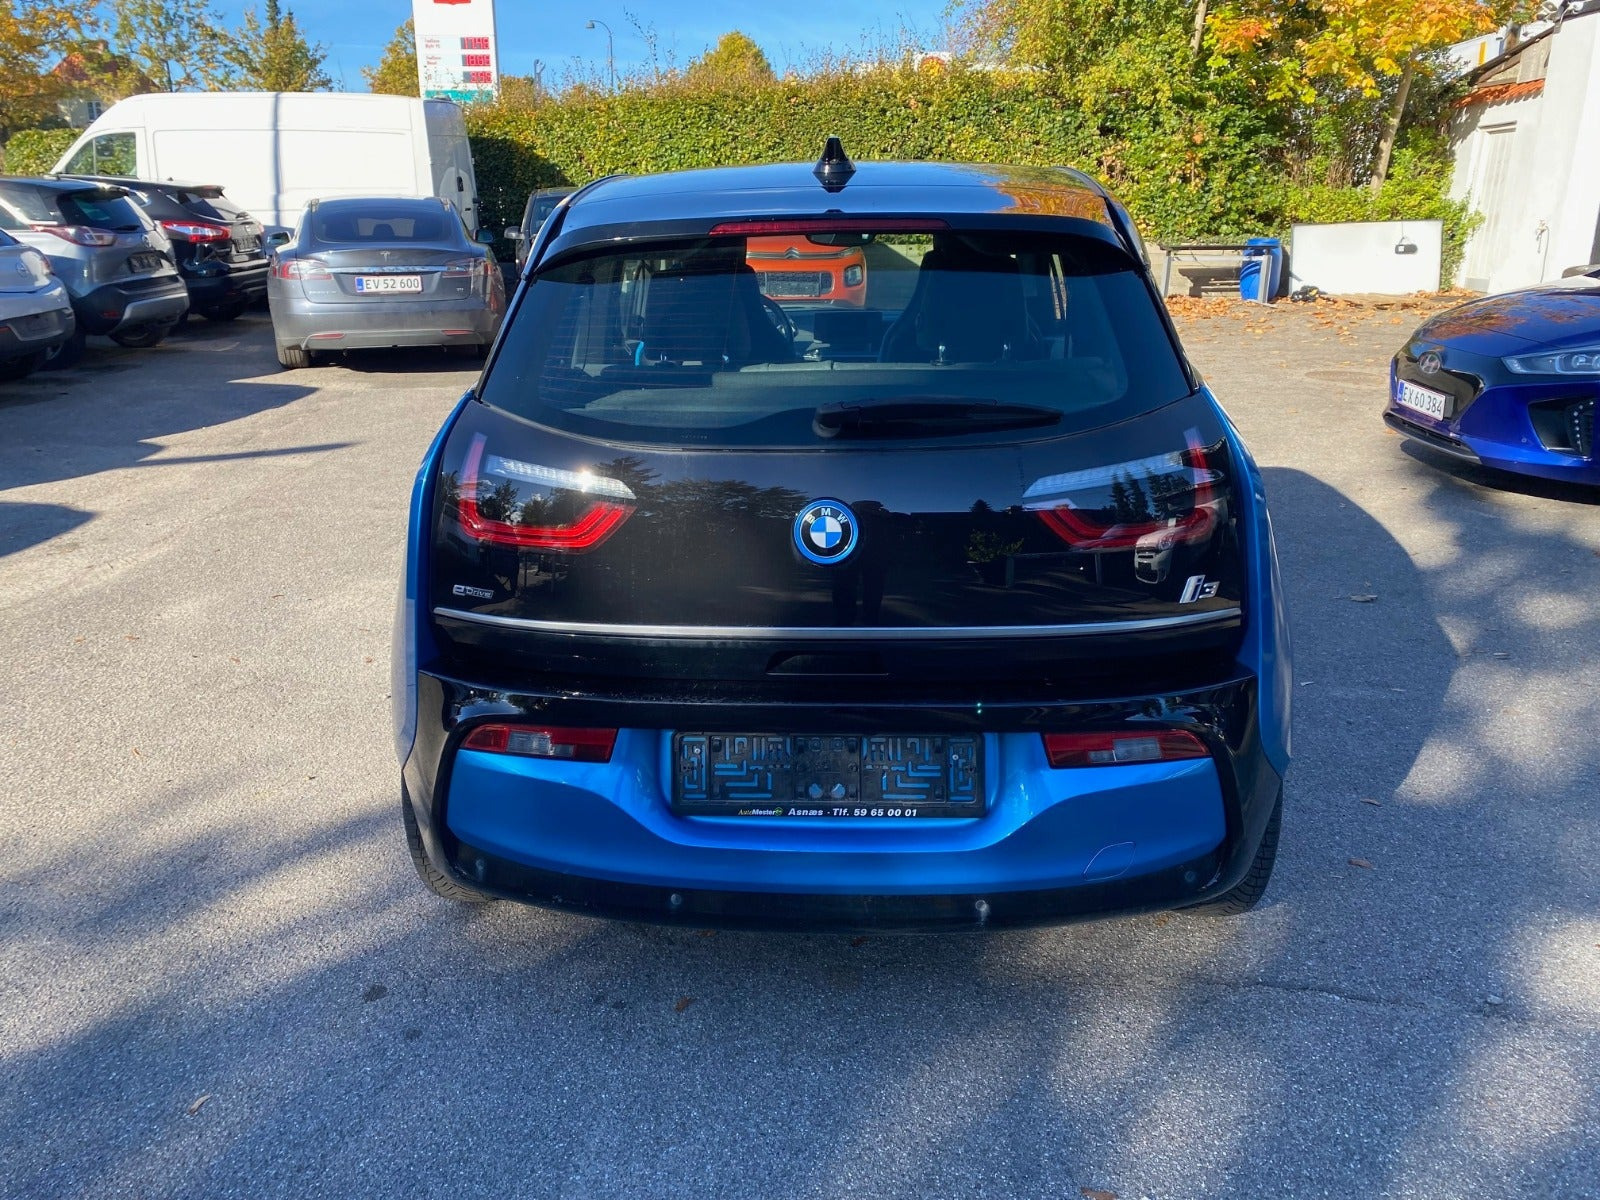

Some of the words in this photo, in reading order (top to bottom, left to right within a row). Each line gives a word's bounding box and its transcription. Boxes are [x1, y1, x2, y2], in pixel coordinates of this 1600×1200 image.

[365, 279, 380, 289] EV
[383, 278, 396, 289] 52
[400, 278, 419, 289] 600
[1403, 386, 1413, 404] EX
[1414, 391, 1425, 408] 60
[1426, 395, 1443, 413] 384
[804, 508, 848, 524] BMW
[1179, 575, 1220, 604] i3
[832, 808, 850, 816] Tlf.
[853, 808, 868, 817] 59
[870, 808, 884, 817] 65
[887, 808, 902, 817] 00
[904, 808, 918, 817] 01
